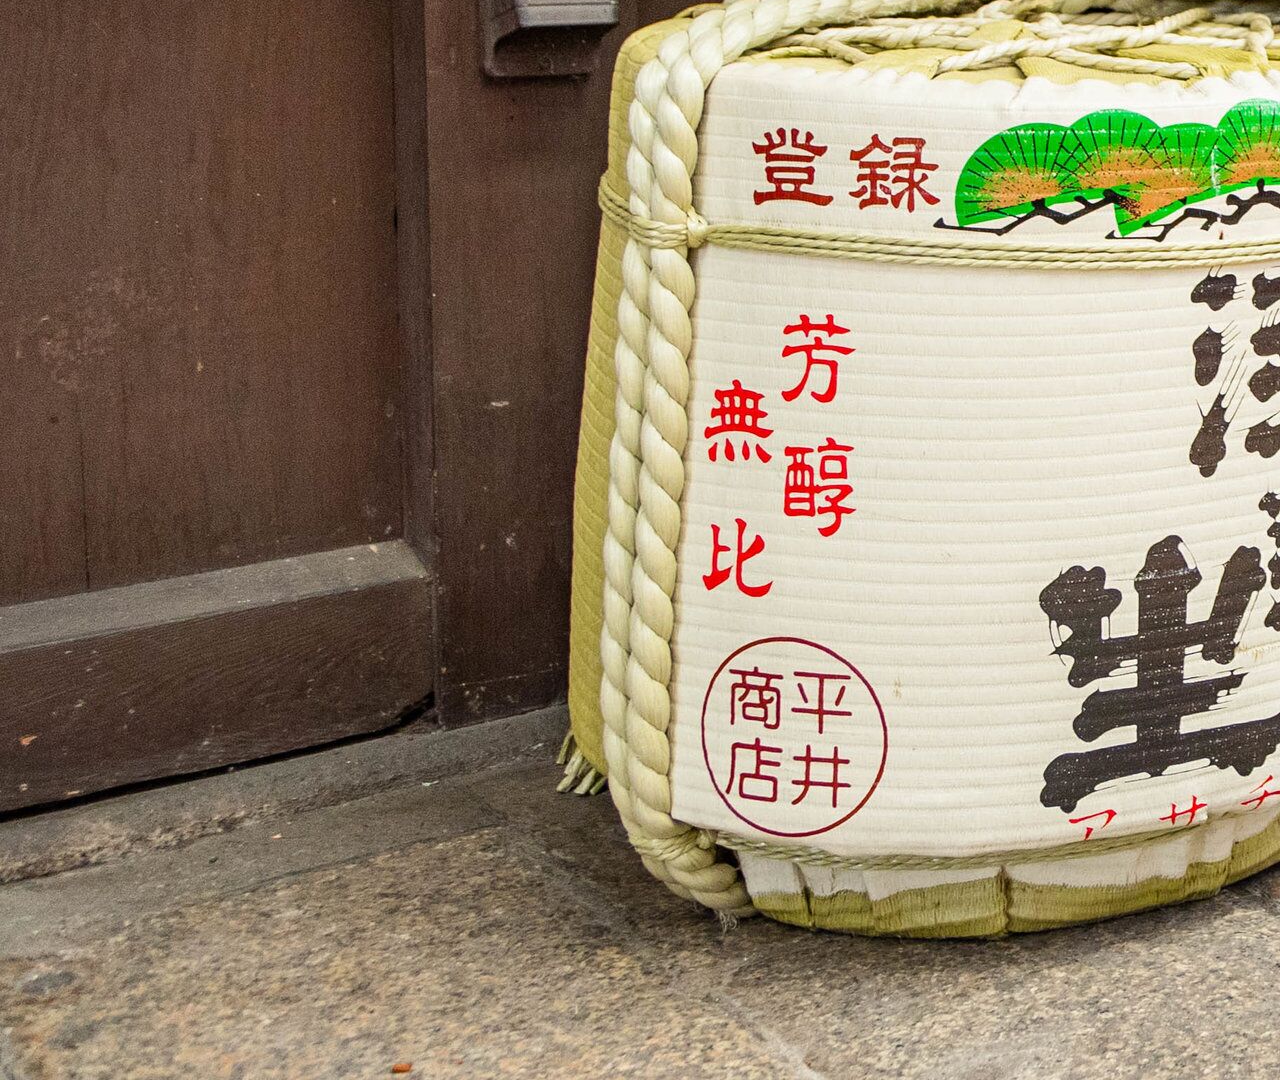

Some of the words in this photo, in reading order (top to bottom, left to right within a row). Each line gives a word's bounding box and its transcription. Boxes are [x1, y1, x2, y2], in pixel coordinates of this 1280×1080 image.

[752, 128, 941, 212] 登録
[701, 378, 774, 598] 無比
[780, 313, 857, 538] 芳醇
